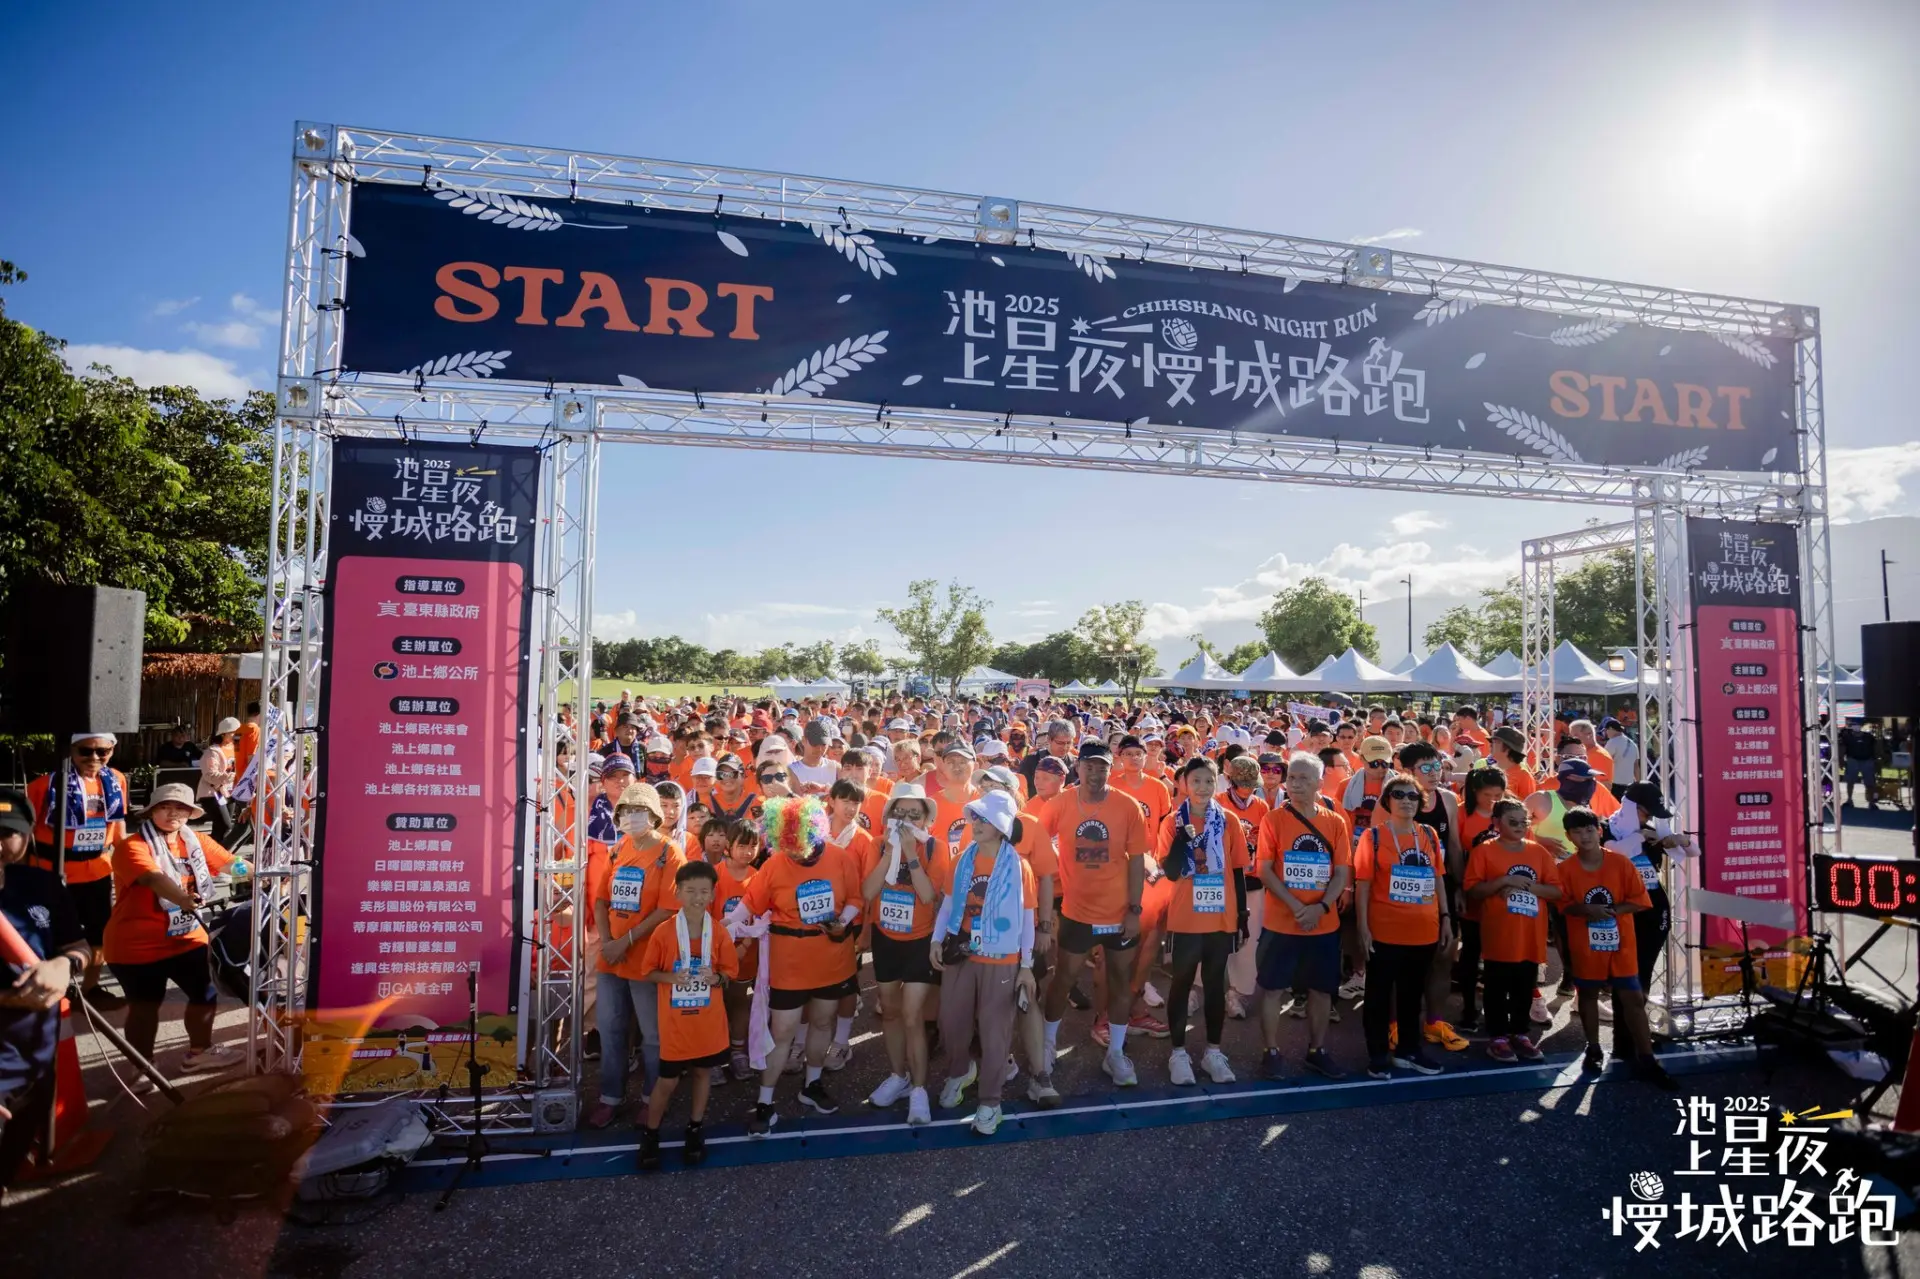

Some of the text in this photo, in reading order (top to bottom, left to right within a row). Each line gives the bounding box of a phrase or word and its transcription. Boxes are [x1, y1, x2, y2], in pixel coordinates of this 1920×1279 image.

[434, 261, 774, 341] START
[1004, 294, 1060, 316] 2025
[1123, 299, 1378, 340] CHIHSHANG NIGHT RUN
[1549, 370, 1750, 430] START
[423, 459, 451, 470] 2025
[349, 504, 519, 544] 慢城路跑
[404, 579, 456, 593] 指導單位
[1699, 567, 1791, 595] 慢城路跑
[403, 602, 480, 619] 臺東縣政府
[400, 640, 453, 653] 主辦單位
[402, 664, 479, 681] 池上鄉公所
[398, 700, 451, 713] 協辦單位
[379, 722, 469, 736] 池上鄉民代表會
[391, 742, 456, 756] 池上鄉農會
[384, 763, 462, 776] 池上鄉各社區
[364, 783, 481, 797] 池上鄉各村落及社團
[77, 832, 105, 842] 0228
[388, 840, 453, 852] 池上鄉農會
[1286, 867, 1313, 878] 0058
[612, 883, 639, 898] 0684
[1392, 880, 1420, 892] 0059
[1195, 890, 1223, 901] 0736
[1510, 893, 1536, 906] 0332
[802, 897, 832, 913] 0237
[172, 913, 197, 926] 055
[882, 906, 910, 920] 0521
[1592, 931, 1619, 941] 0333
